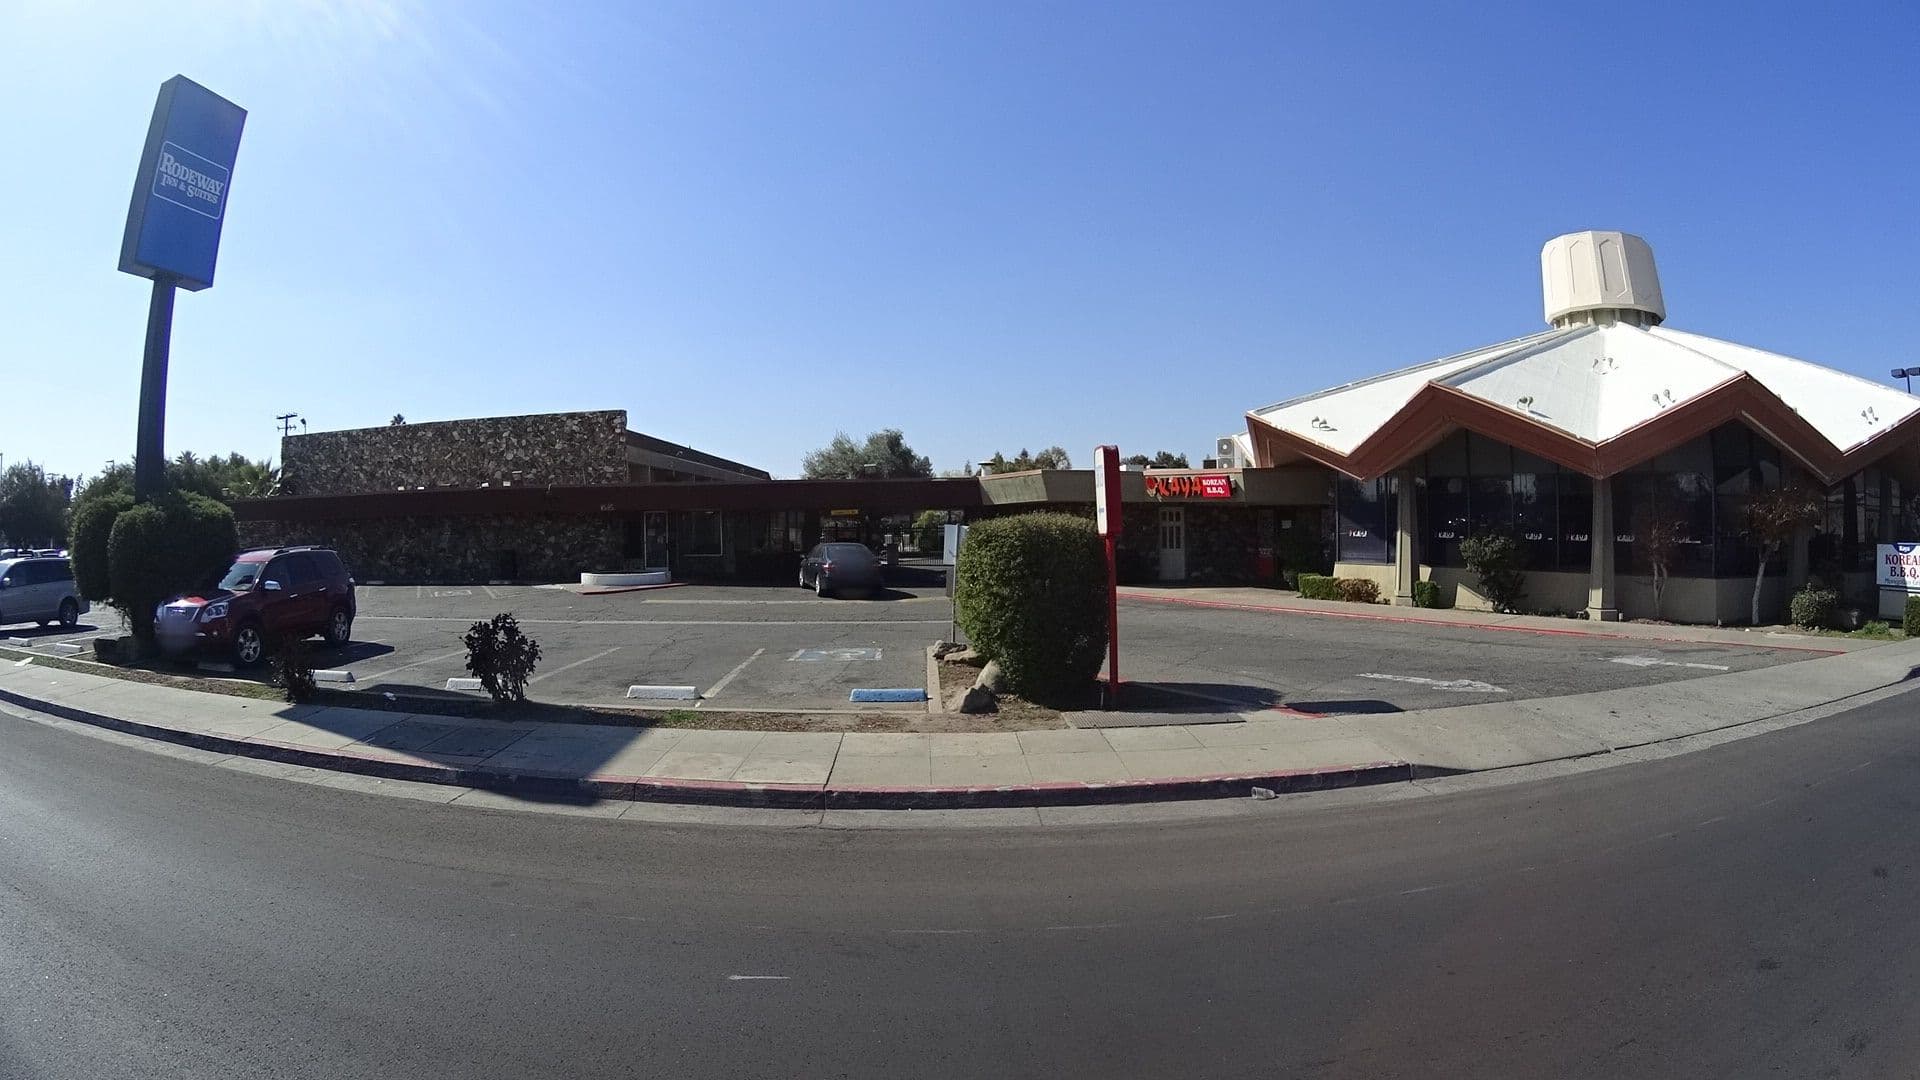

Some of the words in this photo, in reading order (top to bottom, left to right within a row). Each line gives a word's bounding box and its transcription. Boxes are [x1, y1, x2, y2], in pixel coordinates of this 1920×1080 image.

[160, 152, 224, 195] RODEWAY
[161, 174, 178, 187] INN
[178, 181, 186, 191] &
[187, 185, 218, 204] SUITES
[1890, 566, 1919, 579] B.B.Q.
